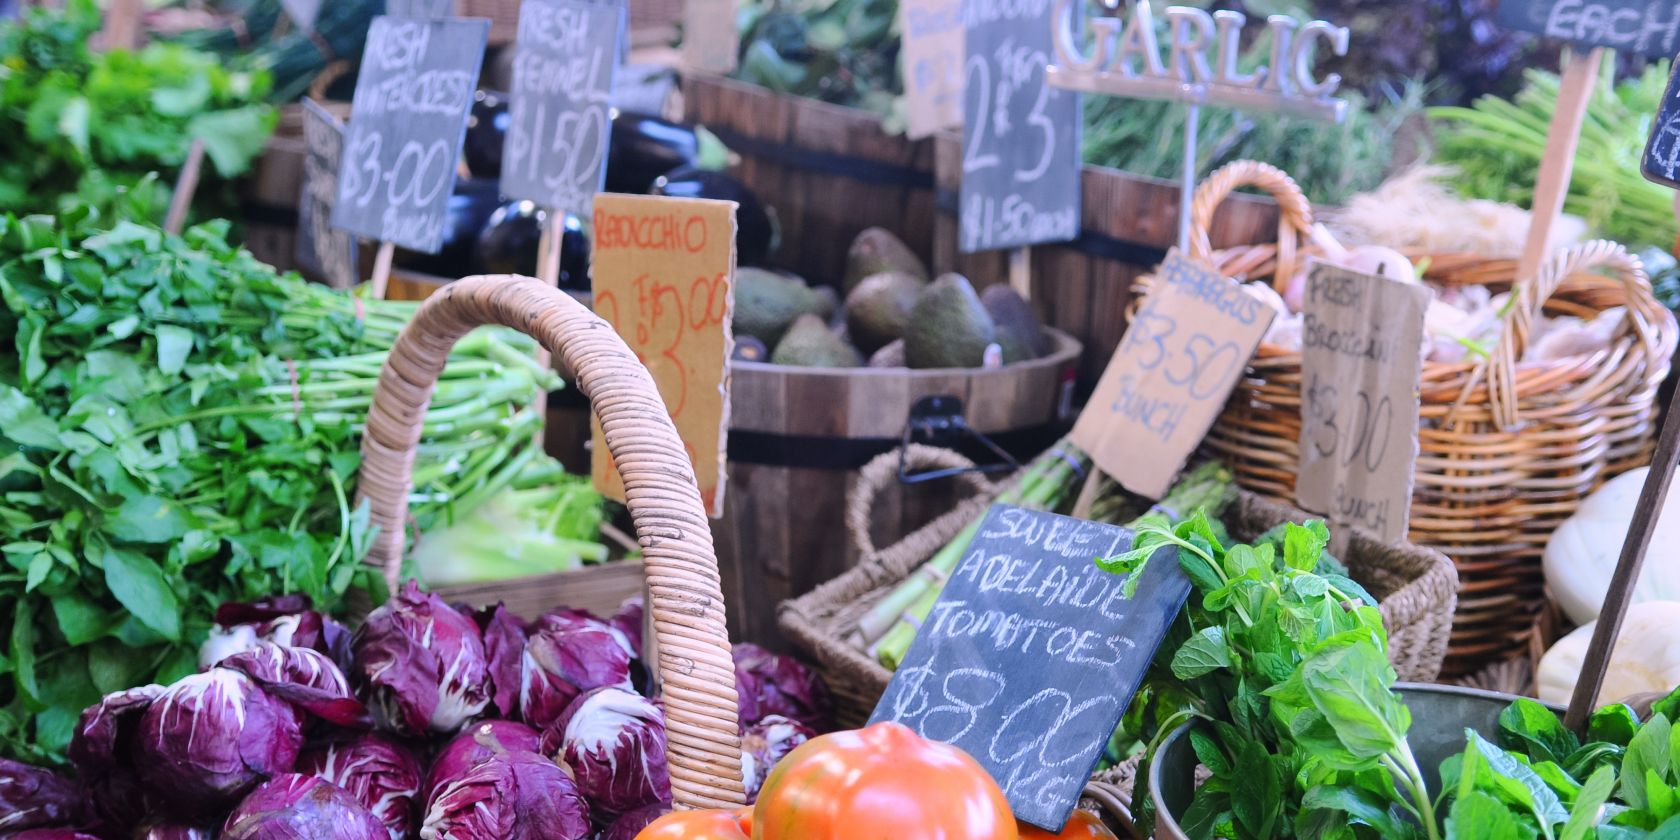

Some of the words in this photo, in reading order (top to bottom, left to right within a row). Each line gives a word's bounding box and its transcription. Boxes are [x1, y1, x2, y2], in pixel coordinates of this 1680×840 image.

[1052, 0, 1350, 98] GARLIC
[1545, 0, 1680, 53] EACH
[964, 53, 999, 172] 2
[1123, 298, 1241, 401] $3.50
[981, 508, 1138, 561] SWEET
[928, 600, 1137, 667] TOMATOES
